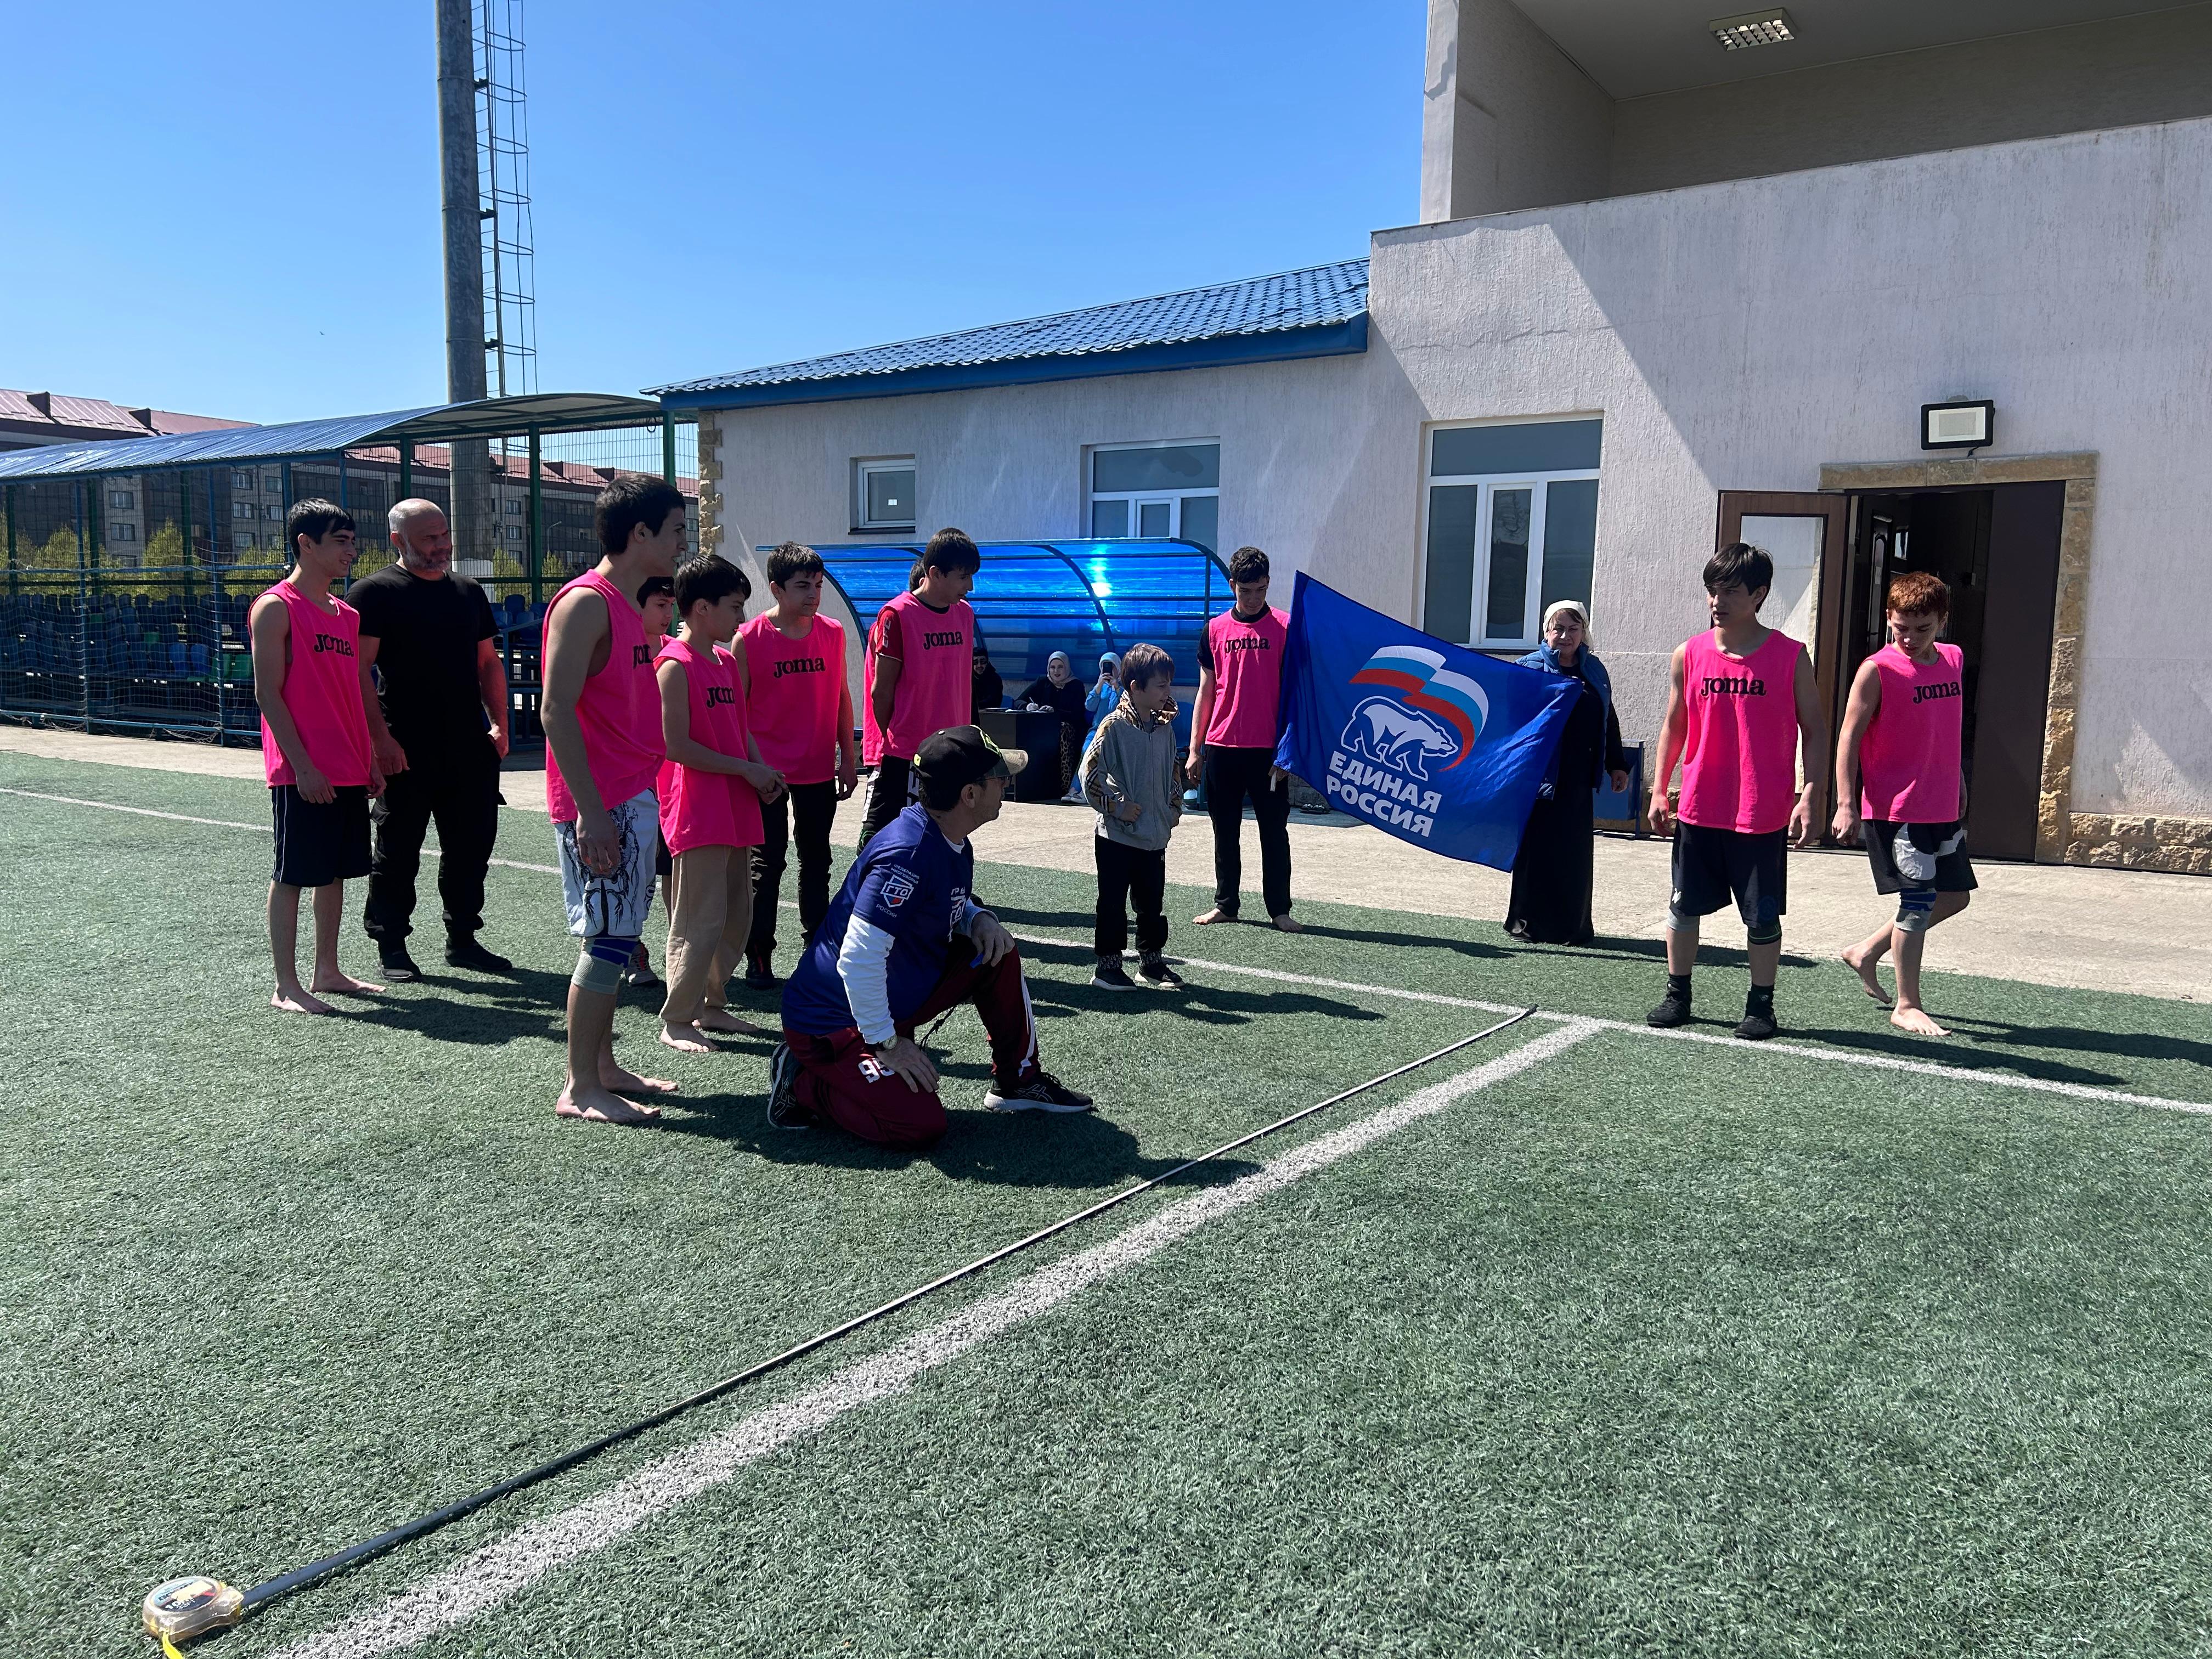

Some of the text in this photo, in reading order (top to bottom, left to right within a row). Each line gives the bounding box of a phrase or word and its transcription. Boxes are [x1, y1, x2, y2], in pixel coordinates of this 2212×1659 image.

[313, 633, 354, 657] Joma
[923, 631, 963, 650] Joma
[1224, 638, 1270, 653] Joma
[773, 657, 826, 678] Joma
[1701, 677, 1767, 696] Joma
[1912, 681, 1961, 704] Joma
[706, 687, 735, 708] Jom
[1329, 751, 1442, 814] ЕДИНАЯ
[1327, 775, 1434, 837] РОССИЯ
[885, 885, 909, 896] ГТО
[876, 904, 898, 918] РОССИИ
